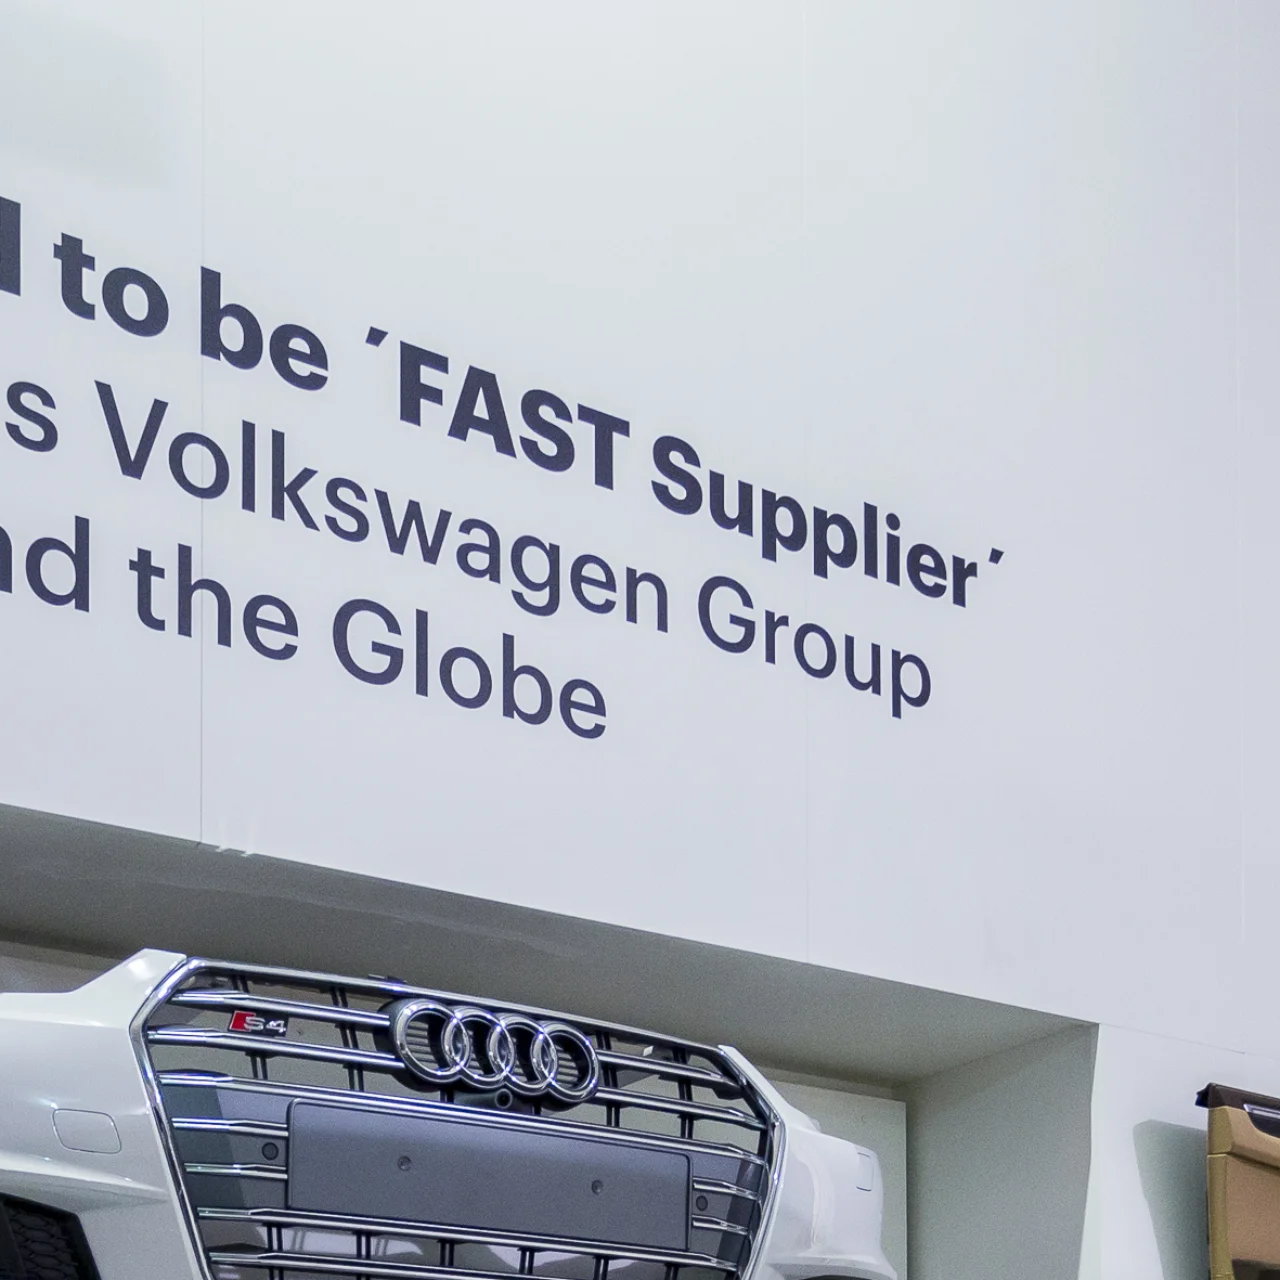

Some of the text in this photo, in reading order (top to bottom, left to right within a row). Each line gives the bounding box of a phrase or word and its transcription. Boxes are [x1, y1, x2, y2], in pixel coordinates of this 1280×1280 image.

[54, 233, 169, 338] to
[201, 266, 329, 391] be
[95, 380, 669, 634] Volkswagen
[697, 575, 932, 720] Group
[128, 544, 299, 661] the
[332, 598, 607, 740] Globe
